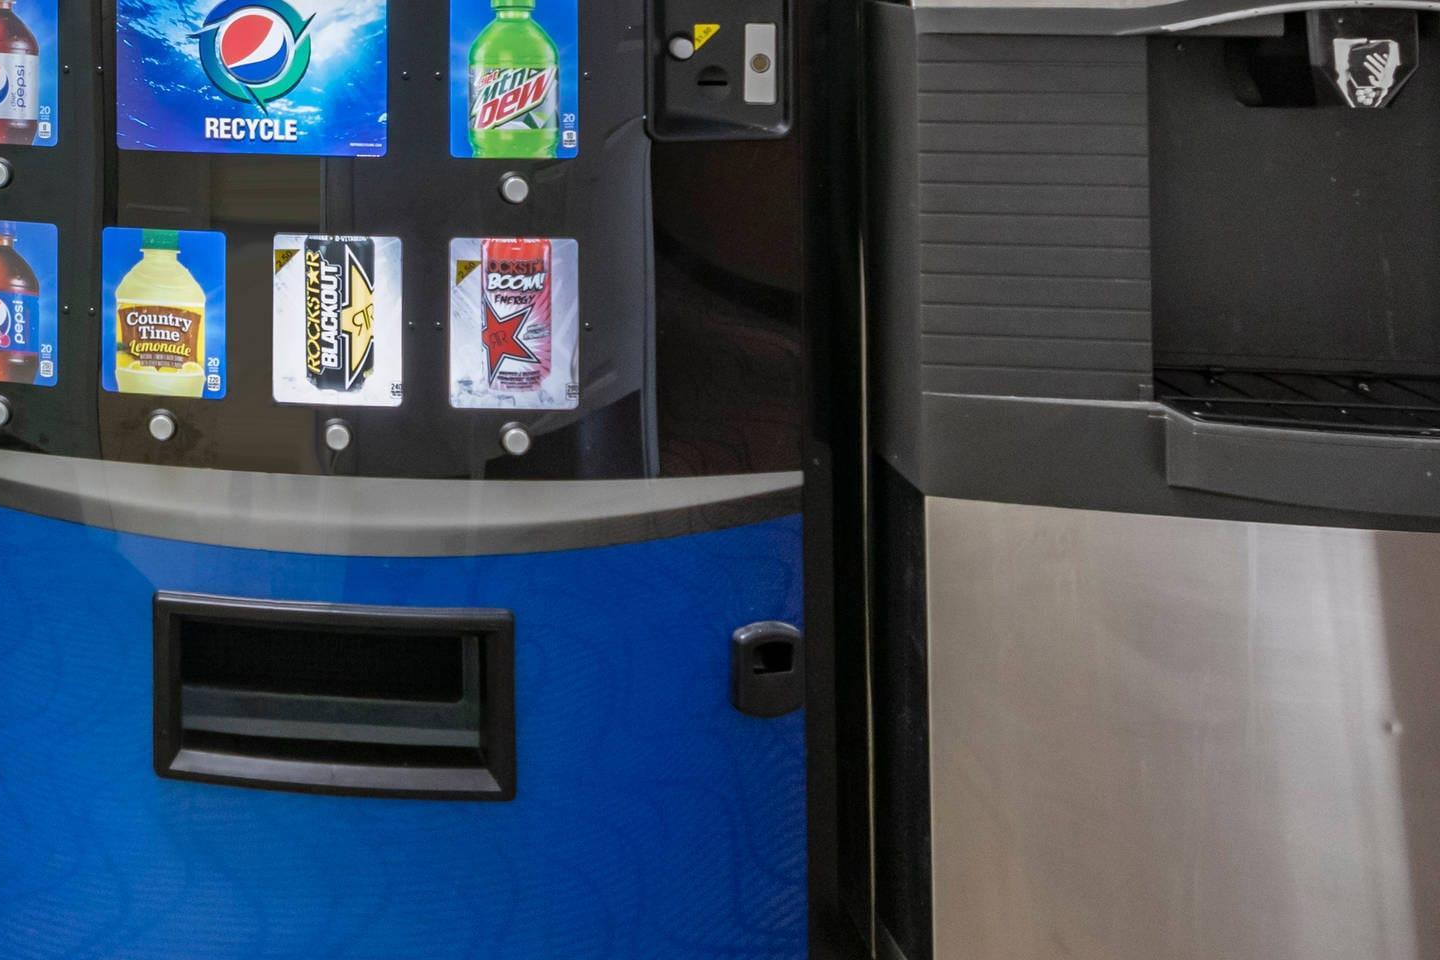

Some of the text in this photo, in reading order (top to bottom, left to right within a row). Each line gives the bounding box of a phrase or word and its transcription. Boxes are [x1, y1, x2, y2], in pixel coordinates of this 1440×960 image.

[15, 64, 27, 109] pepsi
[39, 105, 51, 115] 20
[562, 113, 576, 123] 20
[204, 116, 298, 142] RECYCLE
[487, 272, 546, 291] BOOM!
[494, 294, 536, 306] ENERGY
[12, 299, 26, 345] pepsi
[126, 311, 193, 333] Country
[320, 261, 339, 368] BLACKOUT
[138, 326, 180, 342] Time
[40, 344, 53, 353] 20
[128, 339, 192, 358] Lemonade
[207, 357, 220, 367] 20
